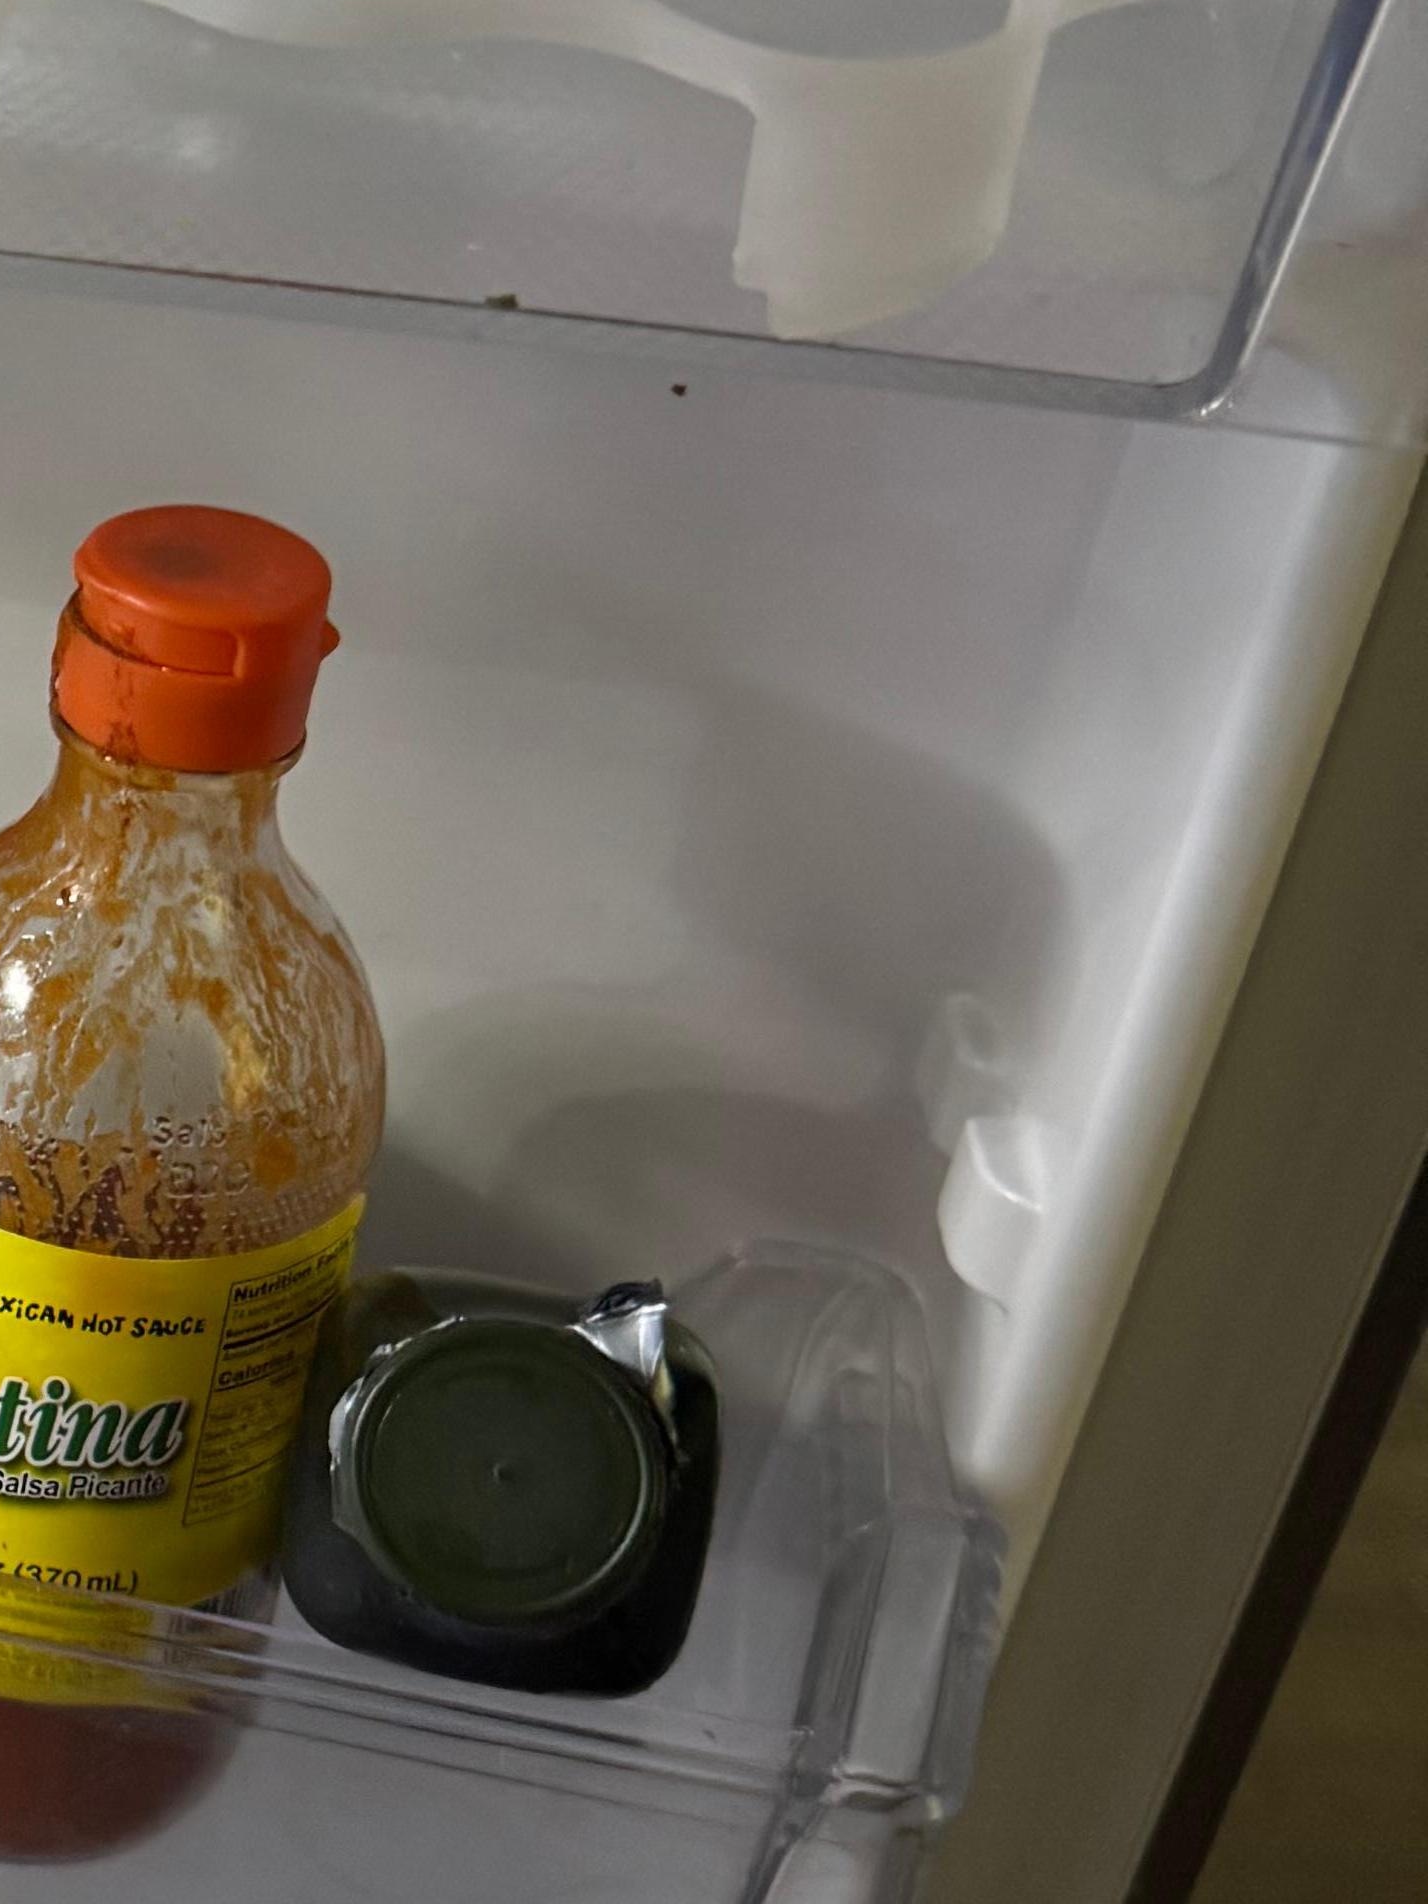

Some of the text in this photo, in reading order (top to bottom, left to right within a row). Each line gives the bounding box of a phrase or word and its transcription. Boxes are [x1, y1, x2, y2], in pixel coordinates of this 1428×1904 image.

[233, 1266, 313, 1303] Nutrition
[81, 1312, 127, 1336] HOT
[130, 1315, 207, 1339] SAUCE
[66, 1470, 168, 1500] Picante
[85, 1569, 140, 1595] mL)
